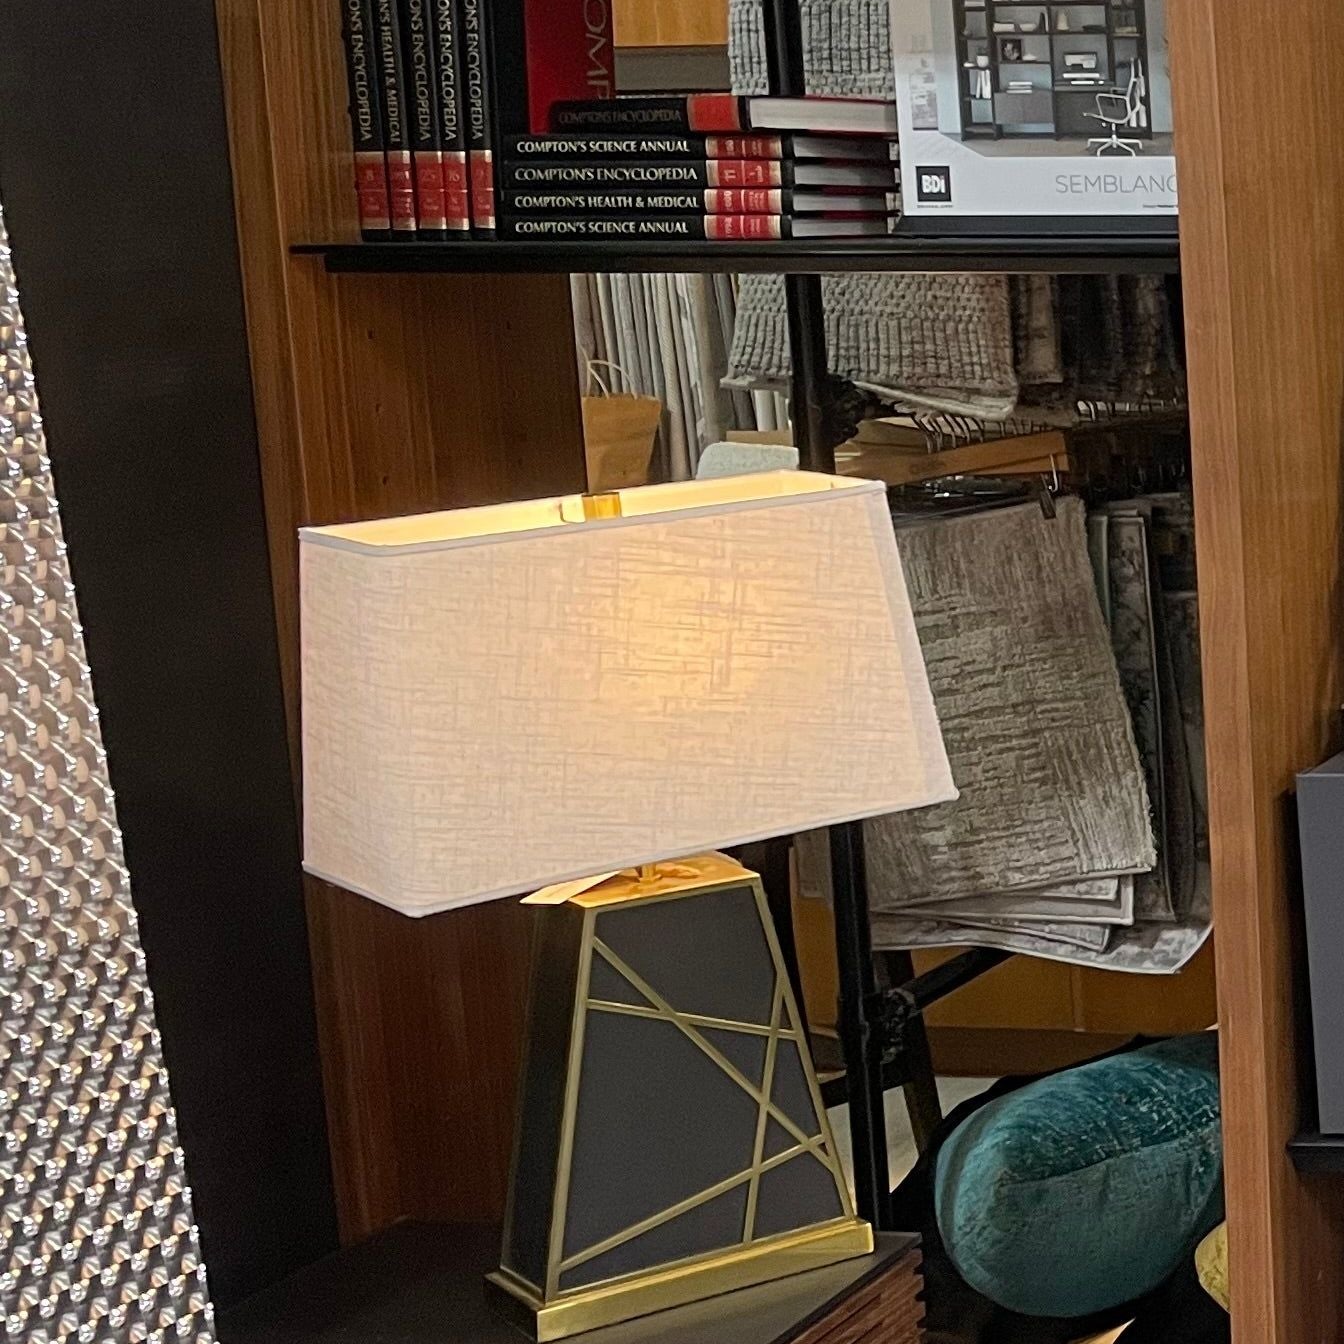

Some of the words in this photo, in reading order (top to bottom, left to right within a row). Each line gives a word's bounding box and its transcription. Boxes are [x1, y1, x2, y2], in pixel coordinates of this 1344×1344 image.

[378, 25, 396, 74] HEALTH
[350, 32, 373, 142] ENCYCLOPEDIA
[410, 32, 432, 141] ENCYCLOPEDIA
[437, 32, 457, 141] ENCYCLOPEDIA
[465, 35, 483, 140] ENCYCLOPEDIA
[386, 89, 401, 143] MEDICAL
[516, 140, 586, 154] COMPTON'S
[589, 140, 637, 154] SCIENCE
[640, 140, 691, 153] ANNUAL
[514, 168, 594, 182] COMPTON'S
[596, 167, 698, 182] ENCYCLOPEDIA
[1055, 174, 1176, 194] SEMBLANC
[514, 195, 586, 209] COMPTON'S
[587, 195, 632, 209] HEALTH
[635, 196, 645, 209] &
[647, 195, 700, 209] MEDICAL
[514, 221, 587, 234] COMPTON'S
[589, 221, 636, 234] SCIENCE
[637, 221, 689, 234] ANNUAL
